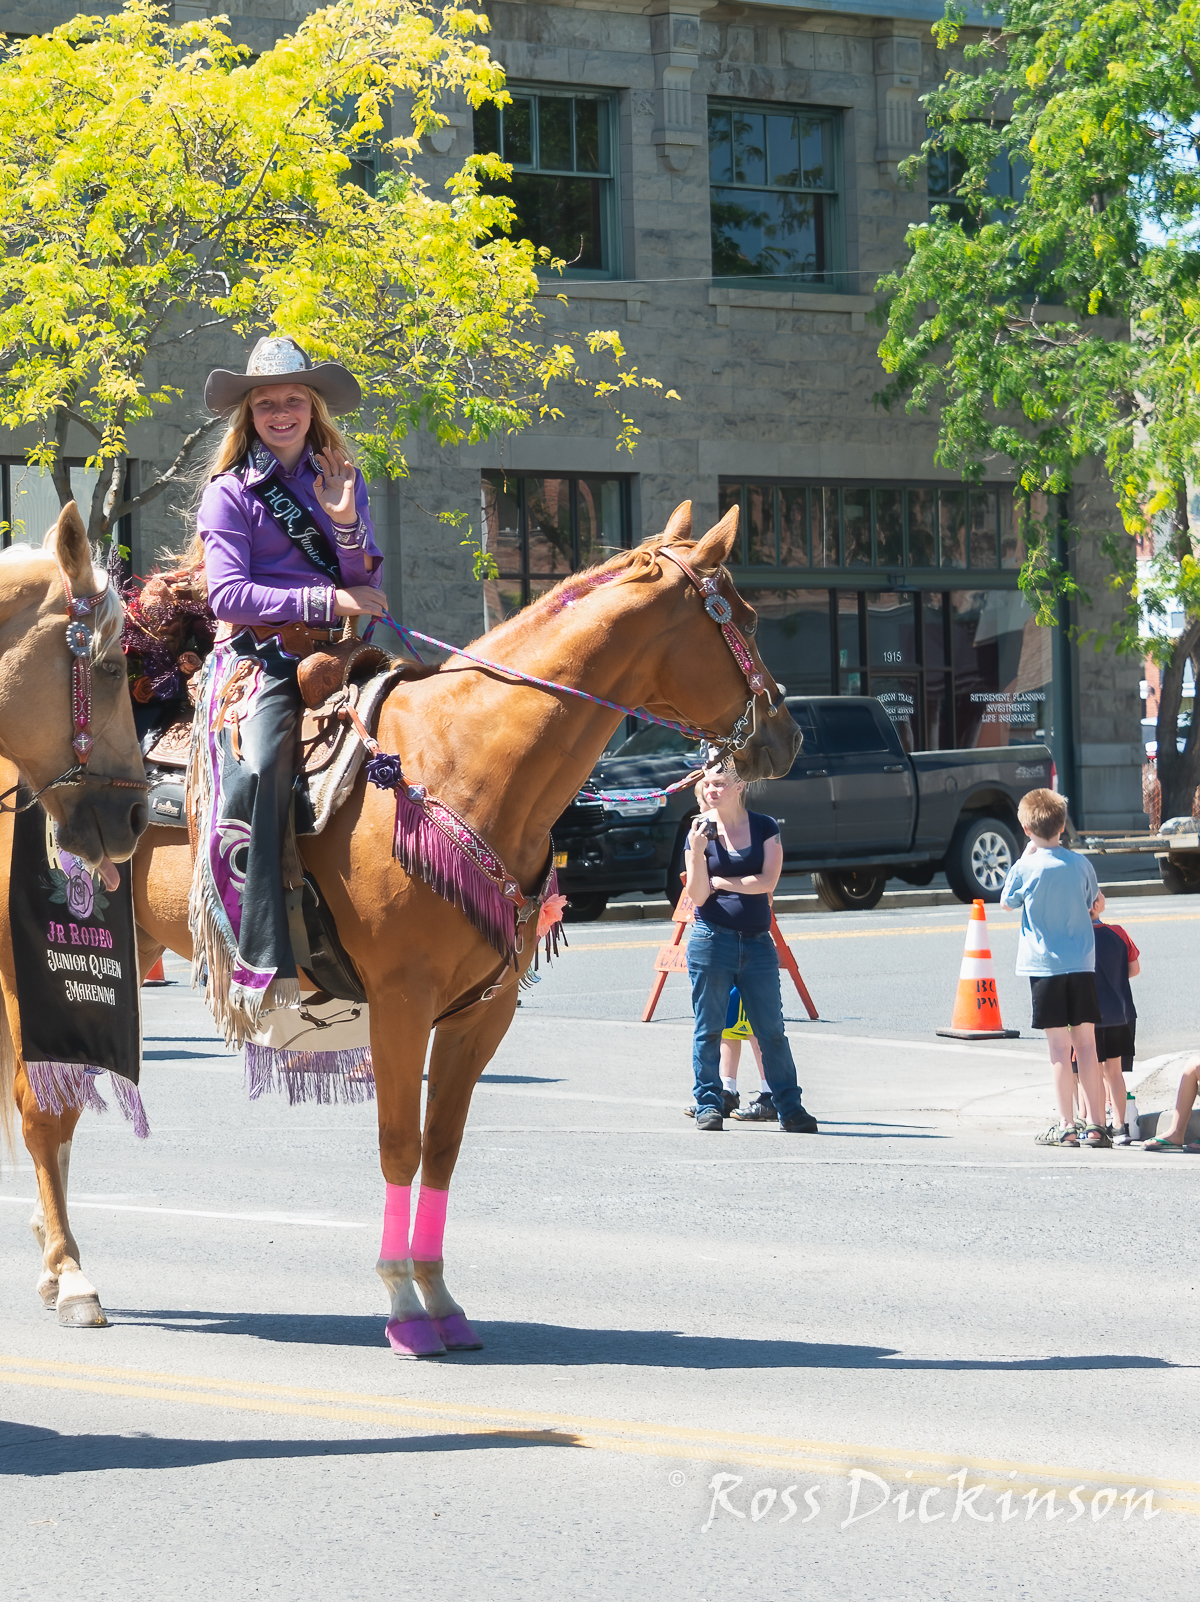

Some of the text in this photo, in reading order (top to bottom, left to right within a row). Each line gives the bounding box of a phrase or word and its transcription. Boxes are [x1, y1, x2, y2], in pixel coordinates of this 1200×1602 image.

[287, 526, 326, 567] Junior
[883, 651, 902, 663] 1915
[970, 692, 1046, 702] RETIREMENT PLANNING
[986, 703, 1030, 712] INVESTMENTS
[982, 713, 1036, 723] LIFE INSURANCE
[47, 921, 113, 949] JR RODEO
[46, 949, 122, 980] JUNIOR QUEEN
[65, 980, 116, 1006] MAKENNA
